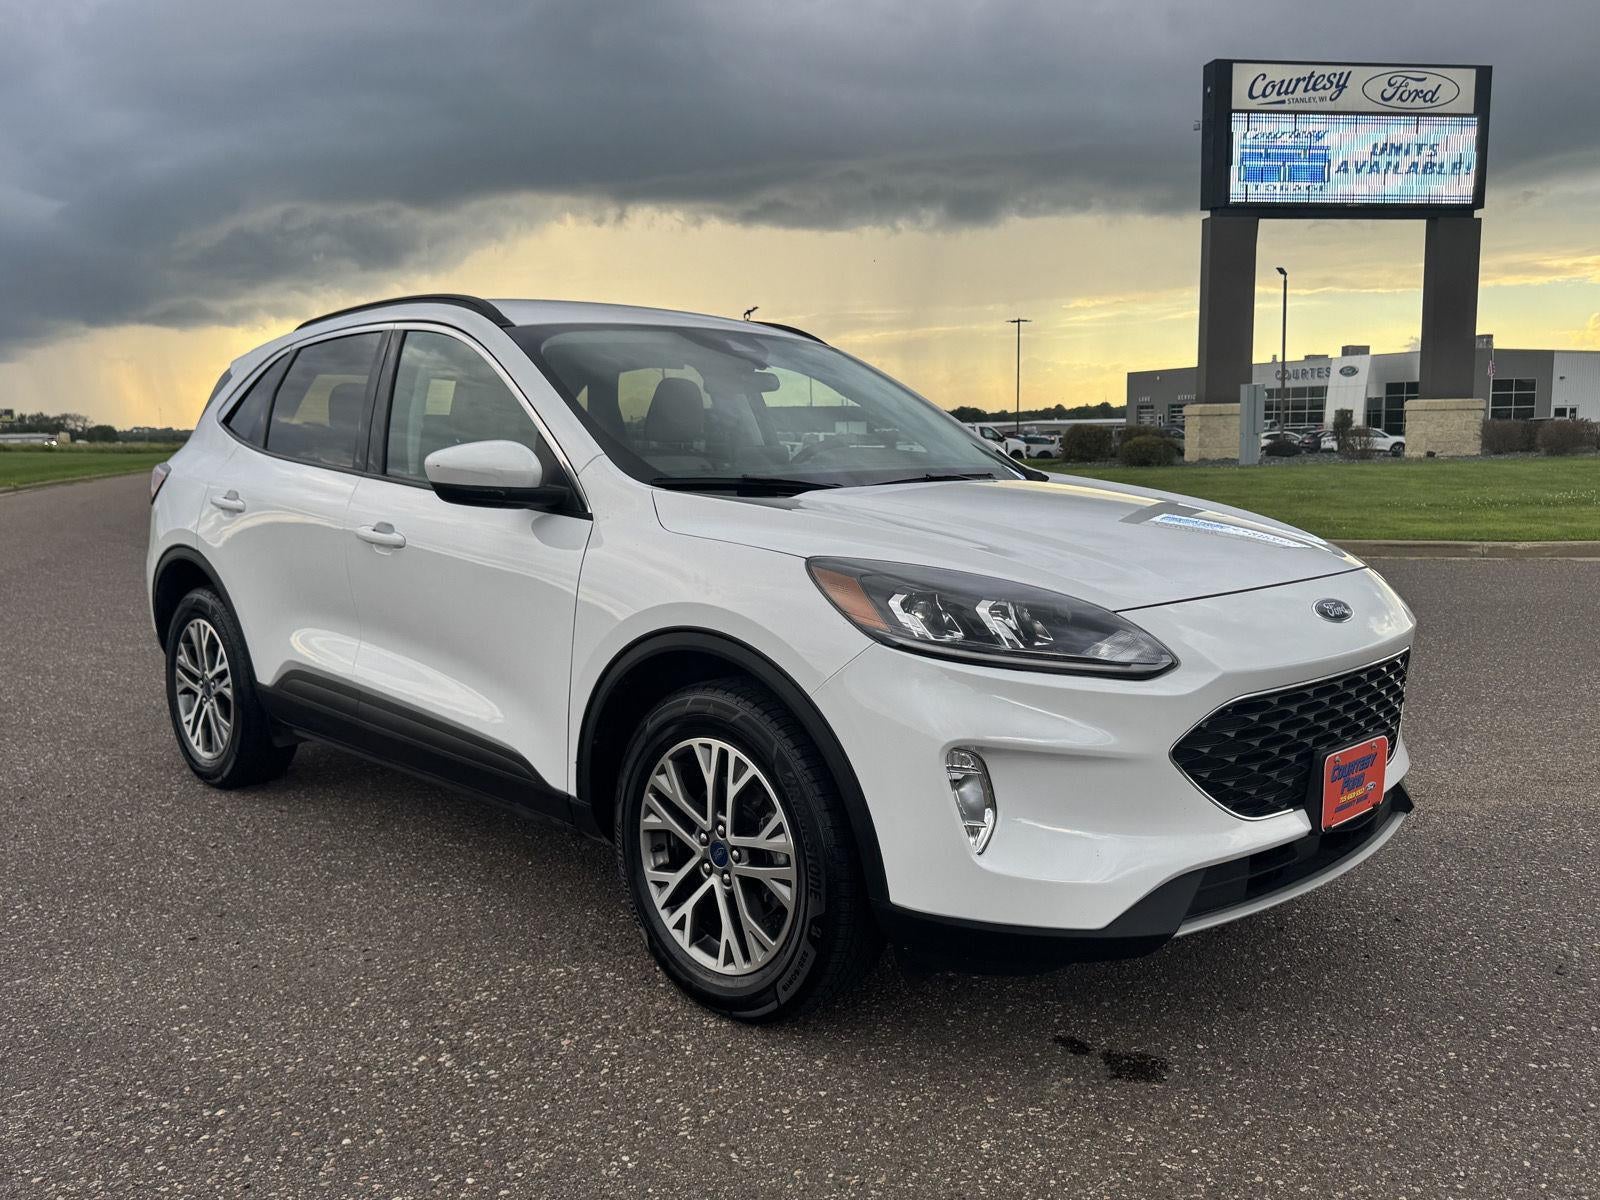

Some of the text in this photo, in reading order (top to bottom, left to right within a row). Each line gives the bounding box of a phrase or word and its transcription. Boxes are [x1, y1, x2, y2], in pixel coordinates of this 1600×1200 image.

[1248, 70, 1352, 101] Courtesy
[1381, 75, 1442, 103] Ford
[1371, 142, 1440, 156] UNITS
[1335, 160, 1472, 175] AVAILABLE!
[1322, 601, 1350, 617] Ford
